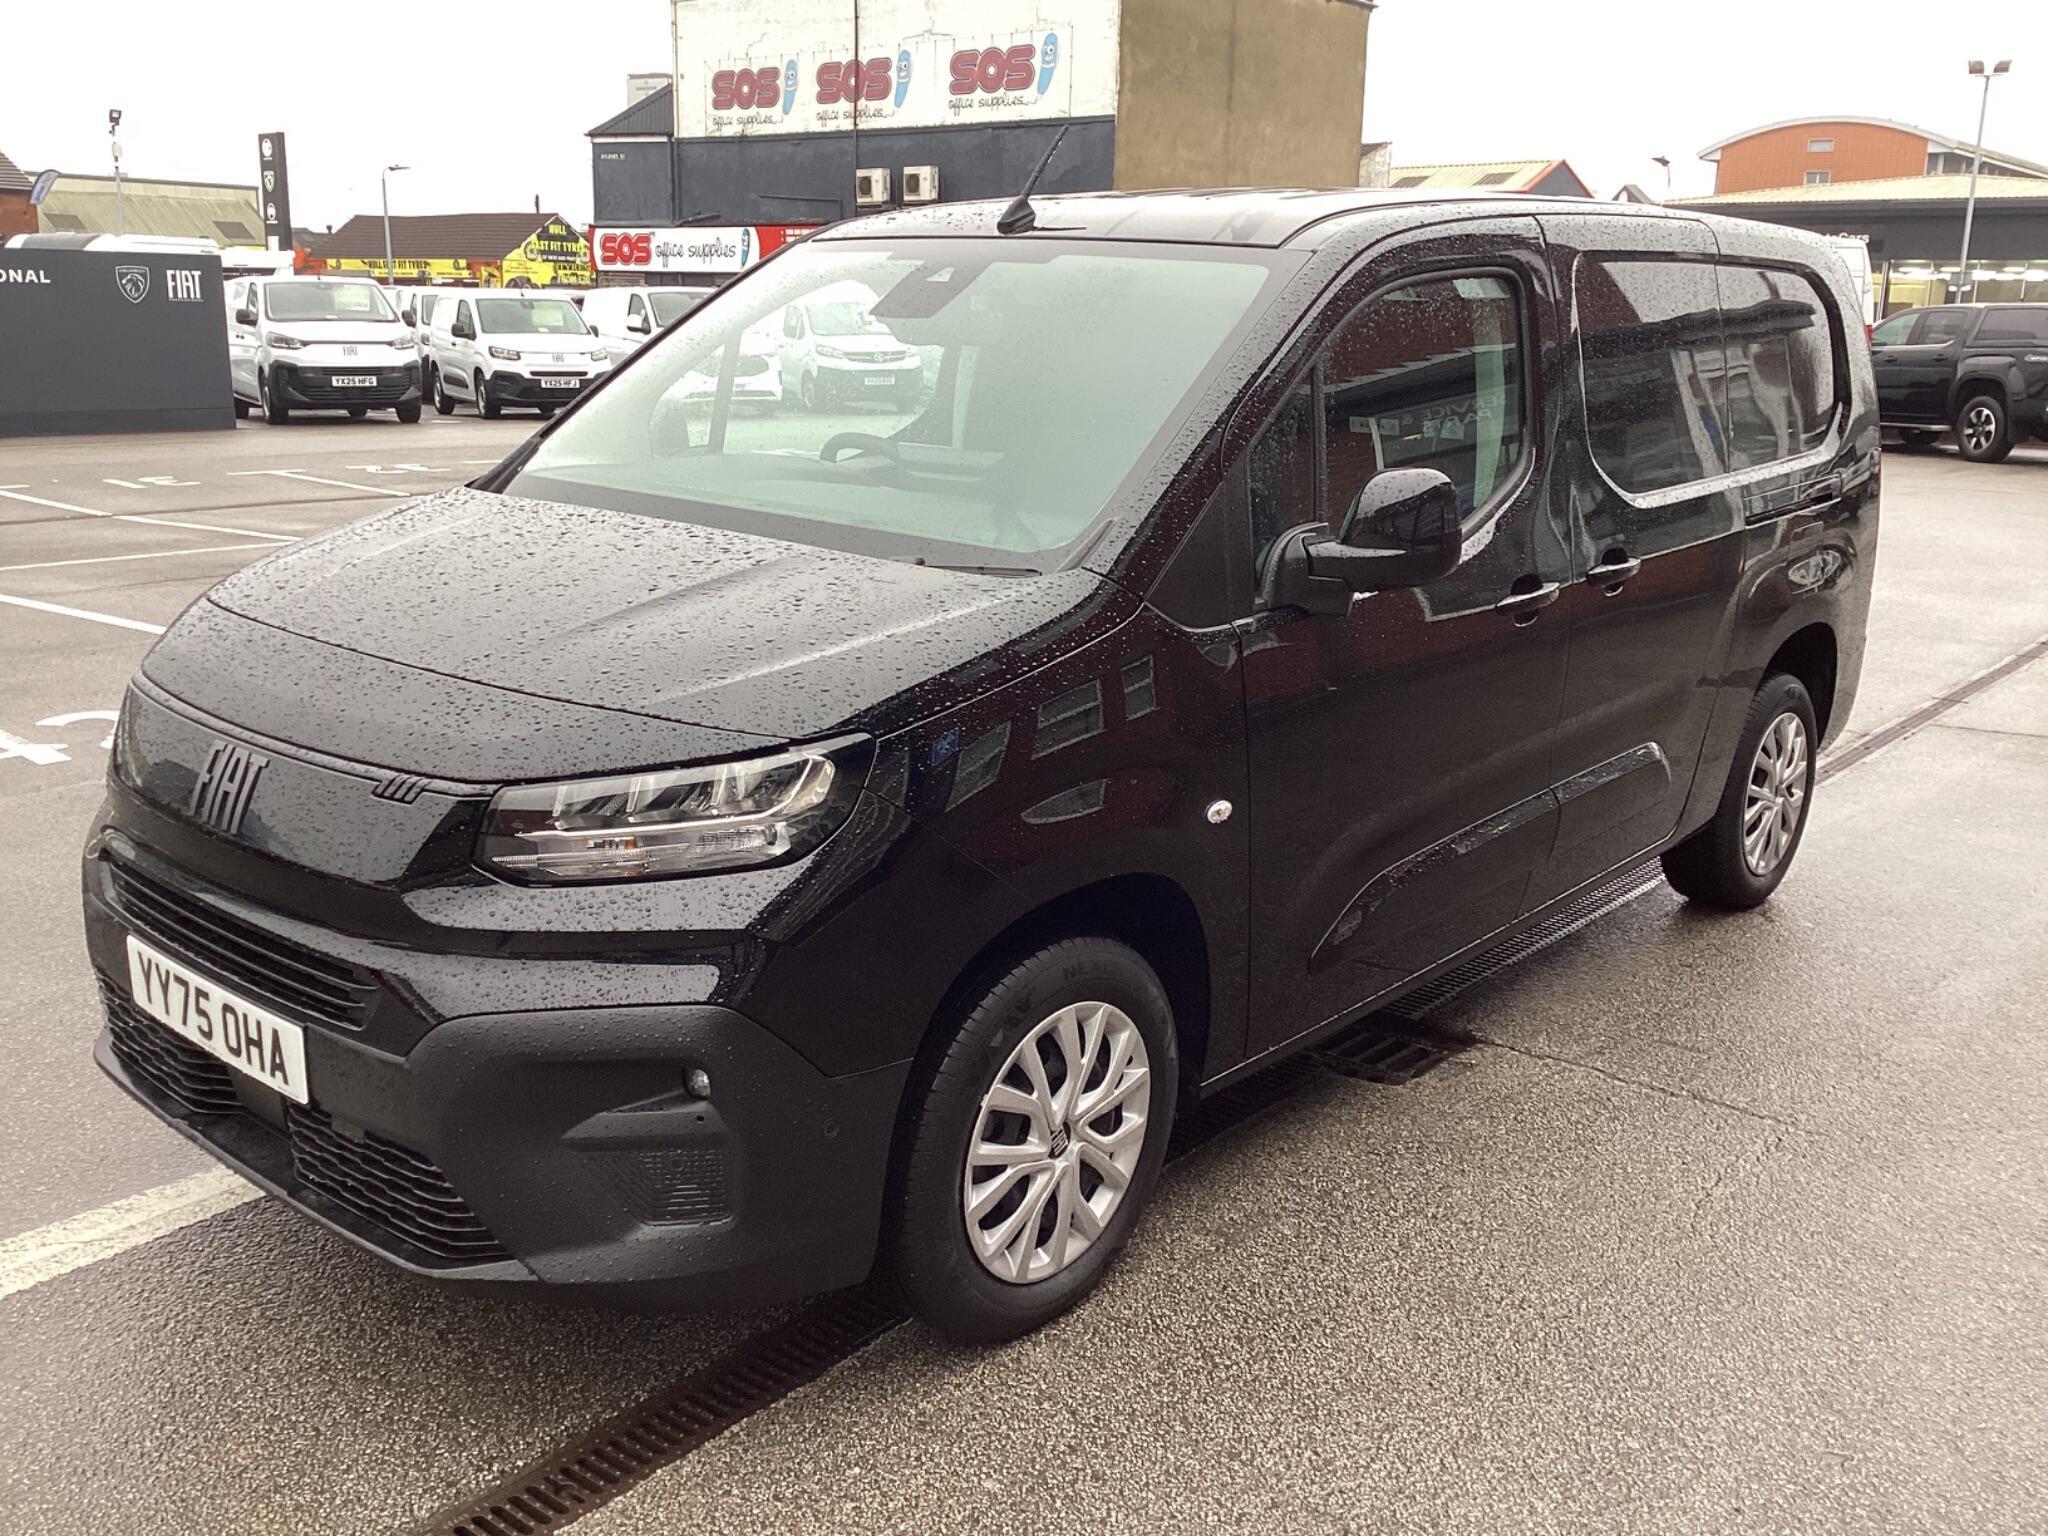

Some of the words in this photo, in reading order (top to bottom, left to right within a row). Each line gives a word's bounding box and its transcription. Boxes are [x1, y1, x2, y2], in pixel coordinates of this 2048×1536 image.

[816, 57, 893, 104] SOS
[949, 44, 1036, 95] SOS
[712, 66, 780, 110] SOS
[948, 97, 974, 116] office
[979, 92, 1024, 111] supplies
[712, 115, 734, 132] office
[736, 112, 776, 130] supplies
[816, 110, 840, 127] office
[843, 104, 886, 122] supplies
[549, 224, 567, 235] HULL
[600, 232, 653, 266] SOS
[655, 240, 684, 268] office
[688, 237, 736, 264] supplies
[166, 269, 202, 299] FIAT
[335, 377, 356, 386] YX25
[190, 740, 270, 835] FIAT
[137, 950, 213, 1042] YY75
[221, 1002, 289, 1086] OHA
